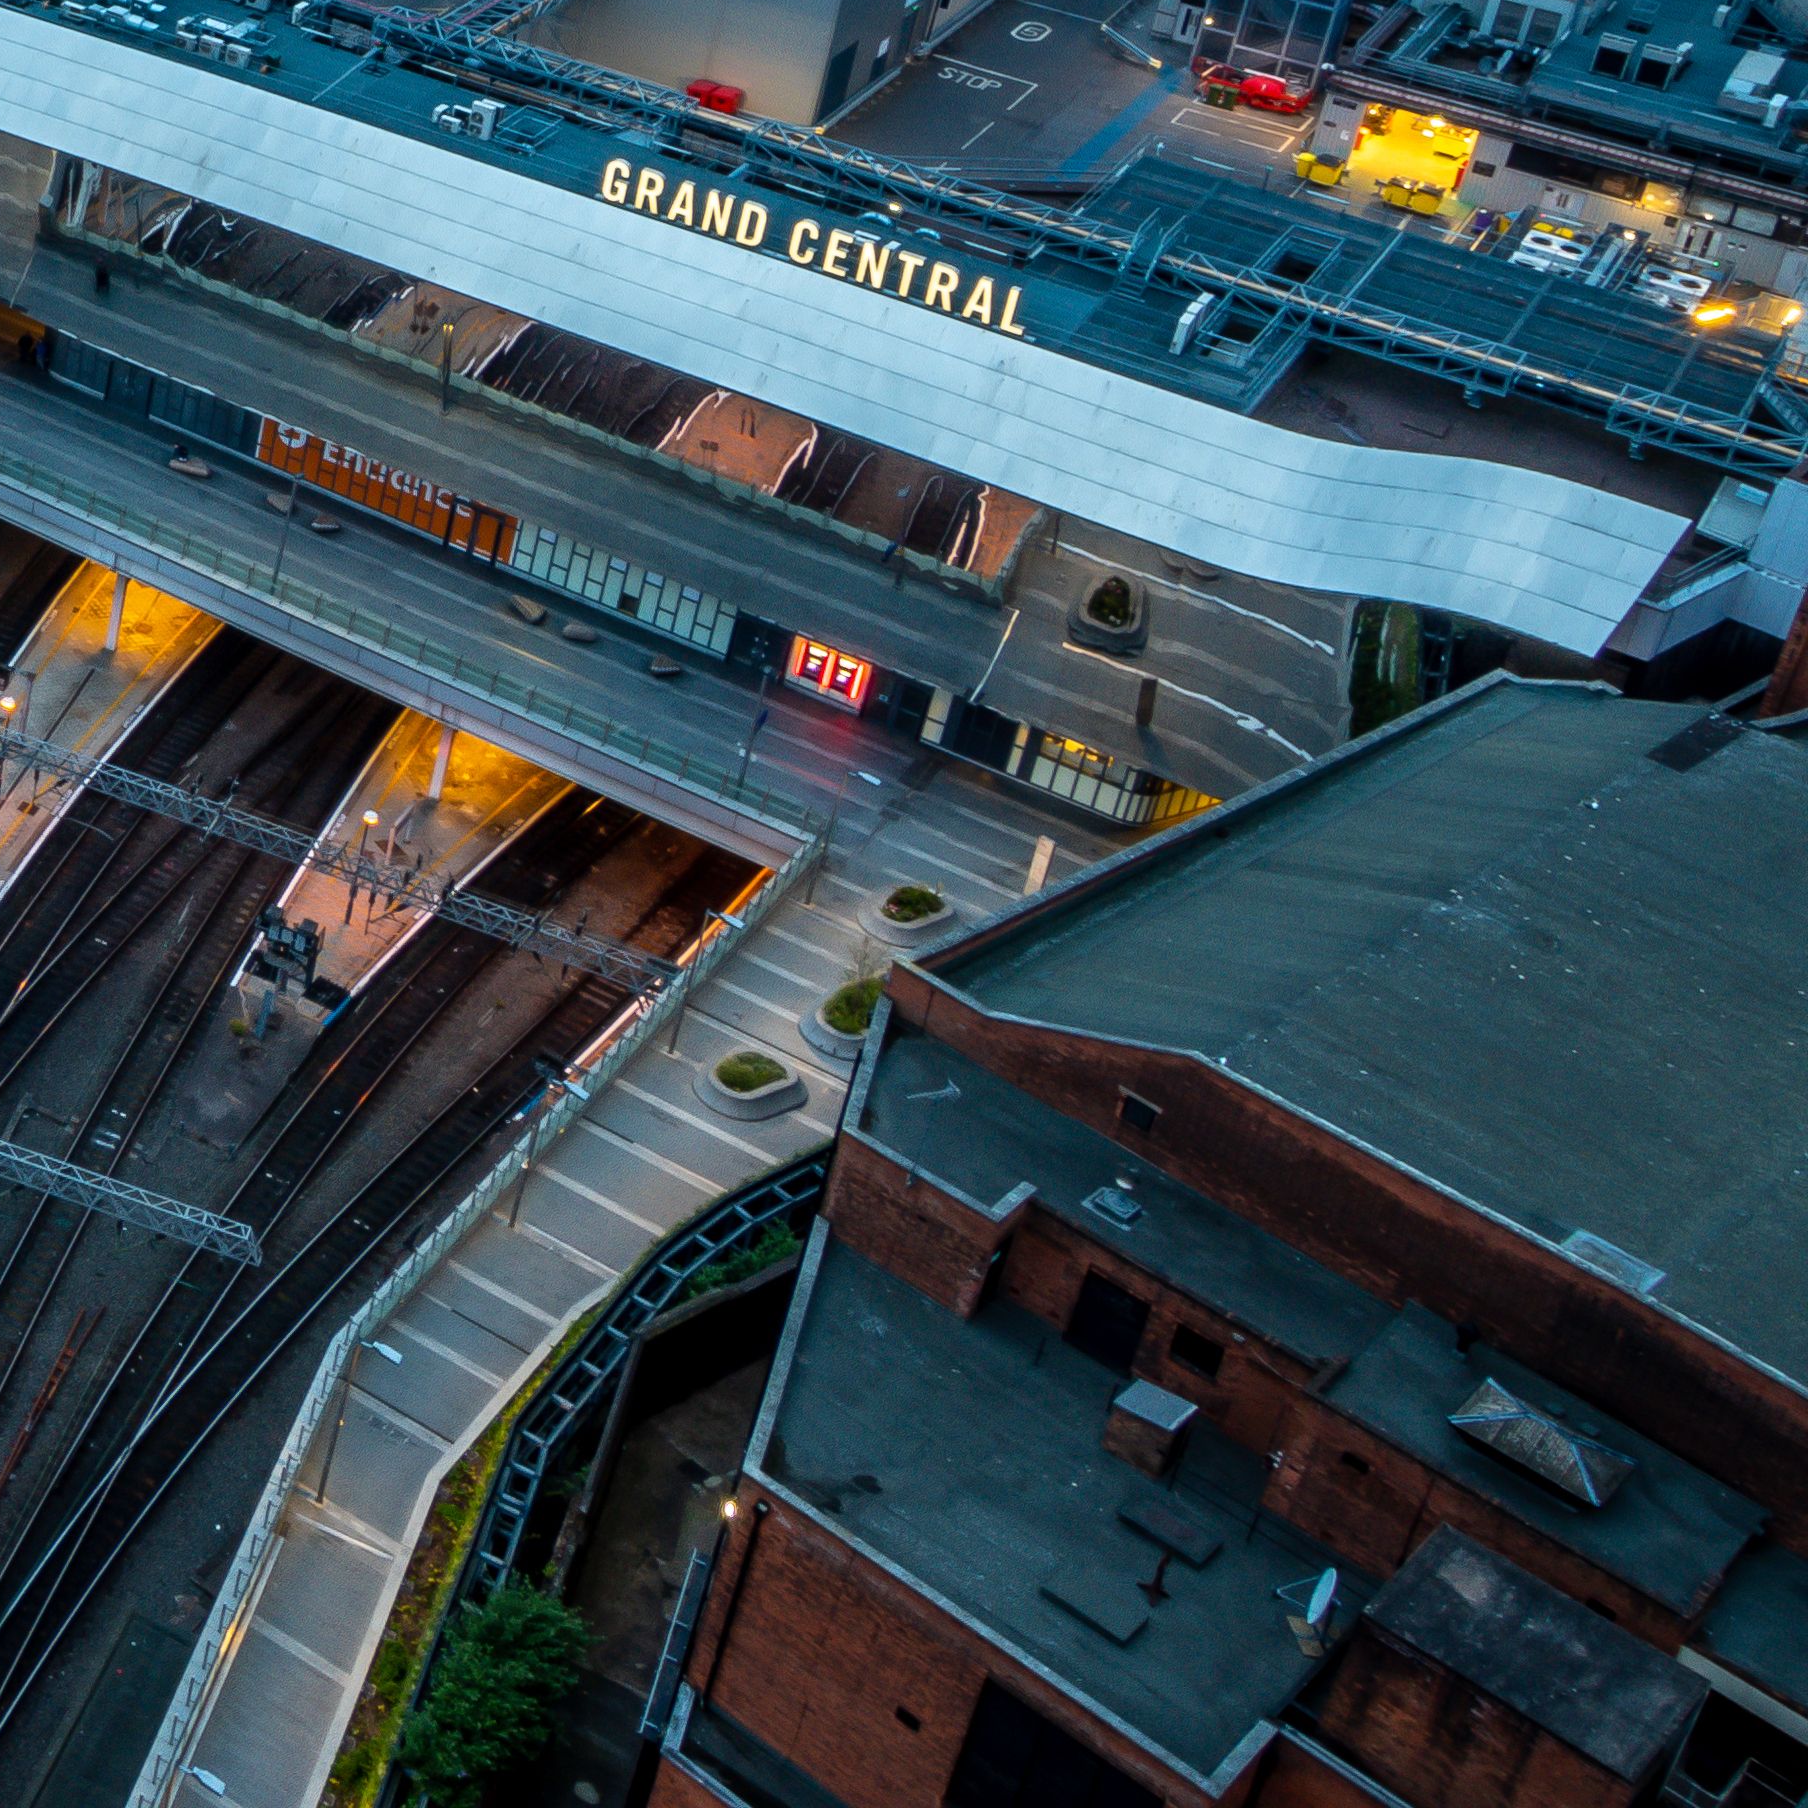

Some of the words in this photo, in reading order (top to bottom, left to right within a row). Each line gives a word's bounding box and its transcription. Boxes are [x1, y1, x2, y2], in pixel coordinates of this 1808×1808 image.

[937, 67, 1002, 90] STOP
[601, 157, 769, 249] GRAND
[788, 218, 1026, 336] CENTRAL
